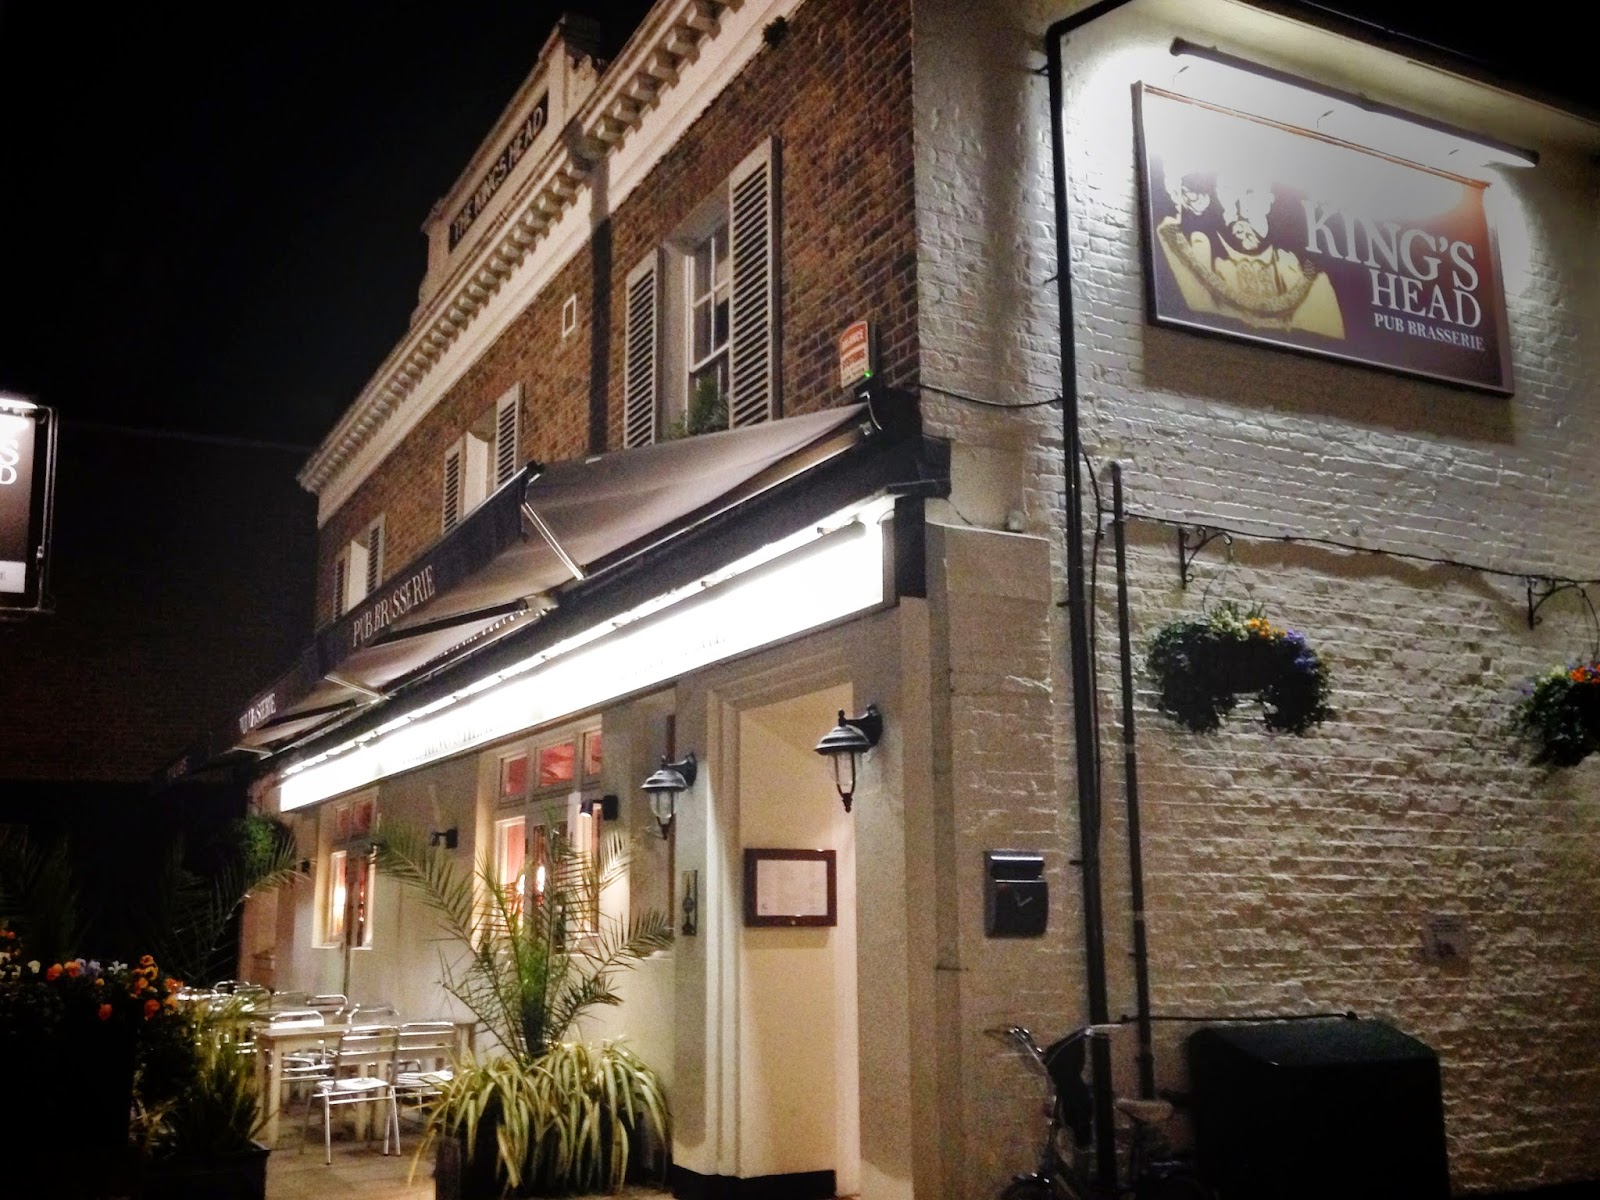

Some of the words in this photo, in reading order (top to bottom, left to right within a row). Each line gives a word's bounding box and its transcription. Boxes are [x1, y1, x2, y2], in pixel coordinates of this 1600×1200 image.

[1301, 199, 1479, 292] KING'S
[1368, 268, 1482, 328] HEAD
[1374, 312, 1405, 333] PUB
[1407, 320, 1485, 351] BRASSERIE
[373, 564, 436, 632] BRSSERIE
